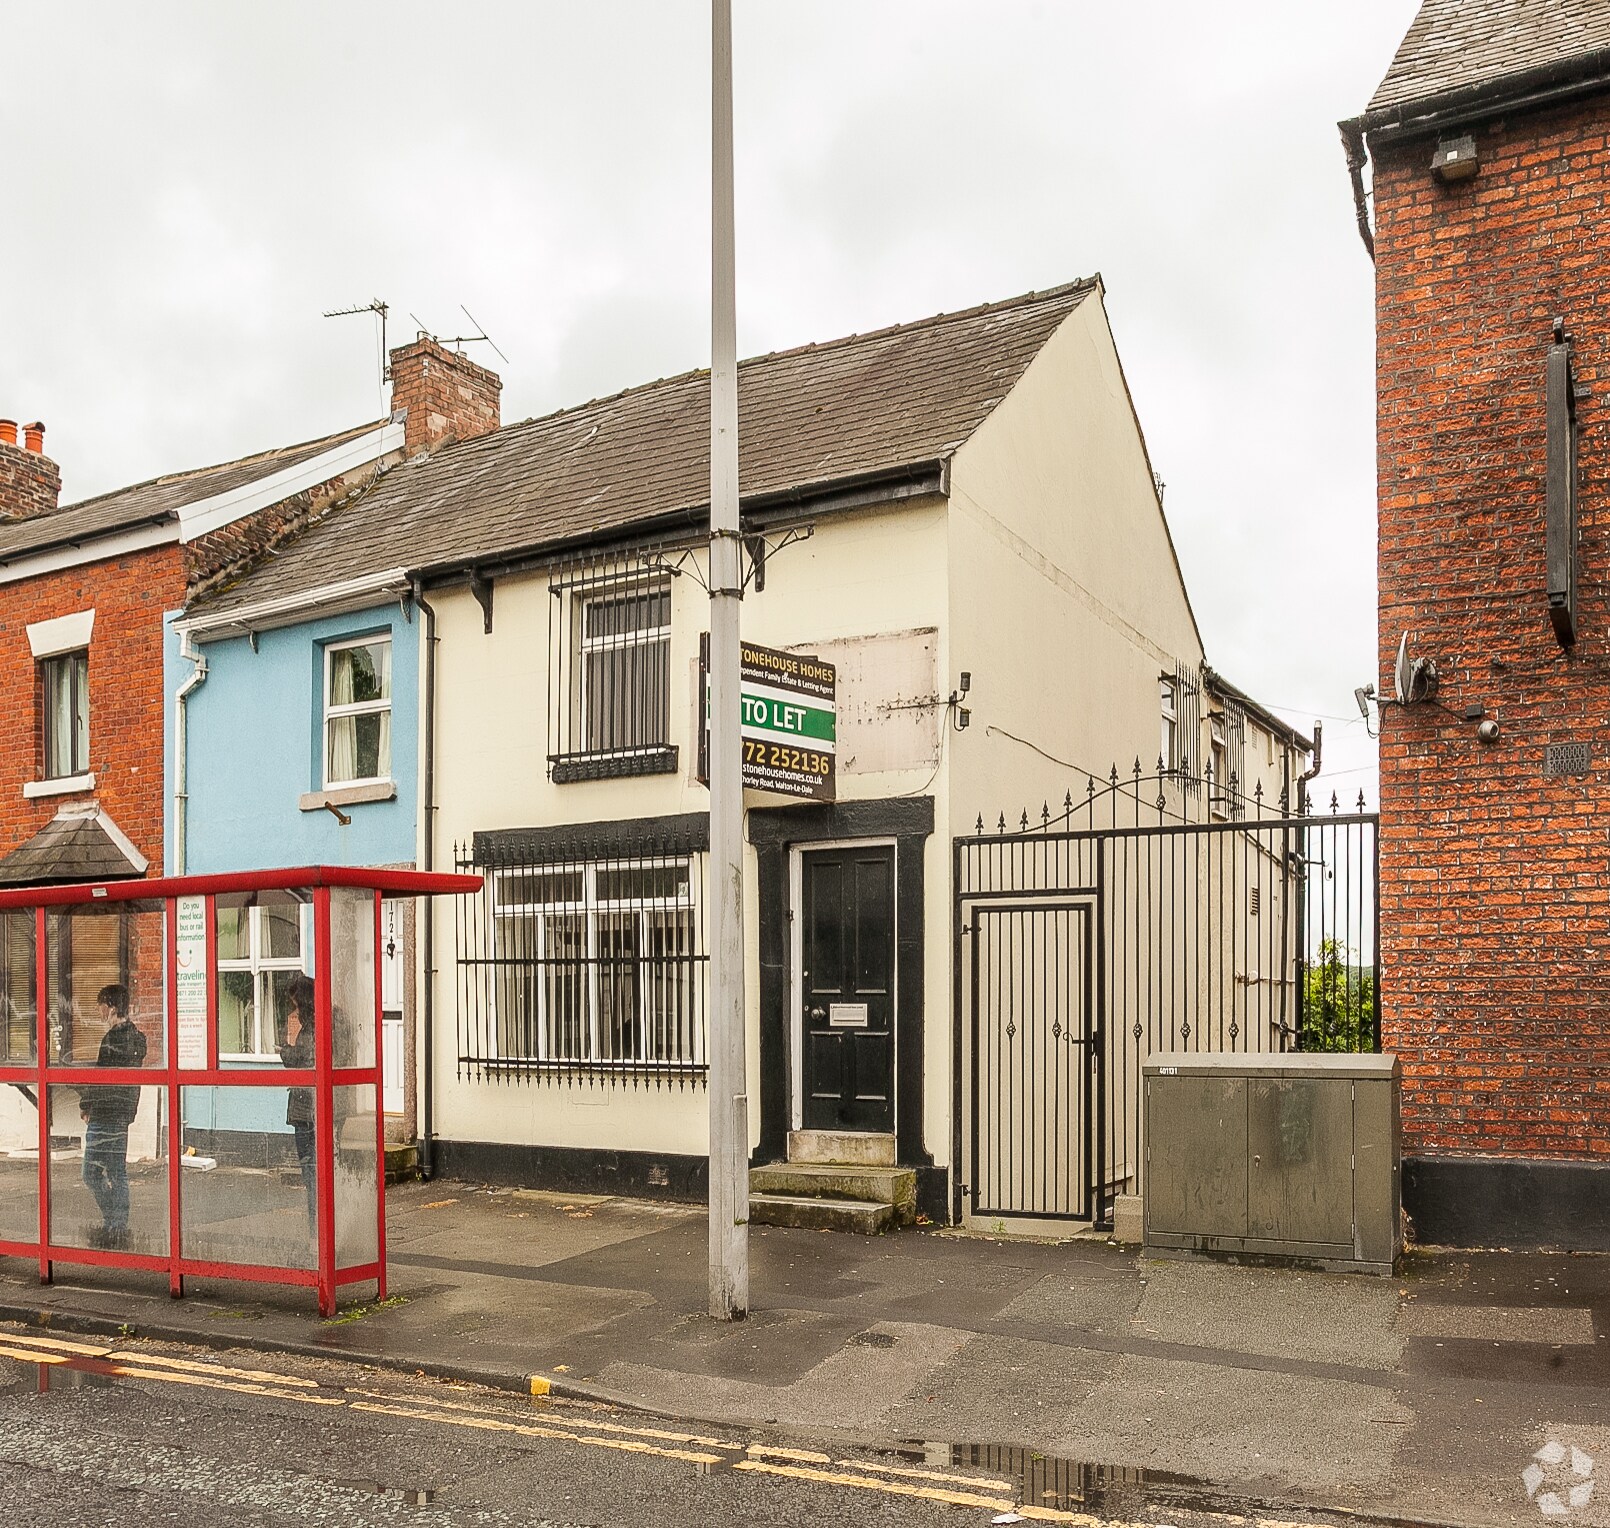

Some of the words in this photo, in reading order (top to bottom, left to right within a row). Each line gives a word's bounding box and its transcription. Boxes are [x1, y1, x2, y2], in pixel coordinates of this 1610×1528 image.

[800, 663, 833, 682] HOMES
[765, 671, 781, 683] Family
[802, 680, 820, 693] Letting
[820, 684, 833, 695] Agent
[742, 698, 767, 724] TO
[773, 704, 806, 731] LET
[742, 741, 765, 763] 72
[770, 747, 829, 775] 252136
[742, 763, 823, 785] stonehousehomes.co.uk
[742, 775, 759, 787] horley
[183, 902, 190, 910] Do
[191, 902, 199, 911] you
[180, 912, 191, 920] need
[192, 911, 203, 920] local
[180, 922, 189, 931] bus
[195, 922, 203, 931] rail
[177, 969, 206, 981] travelin
